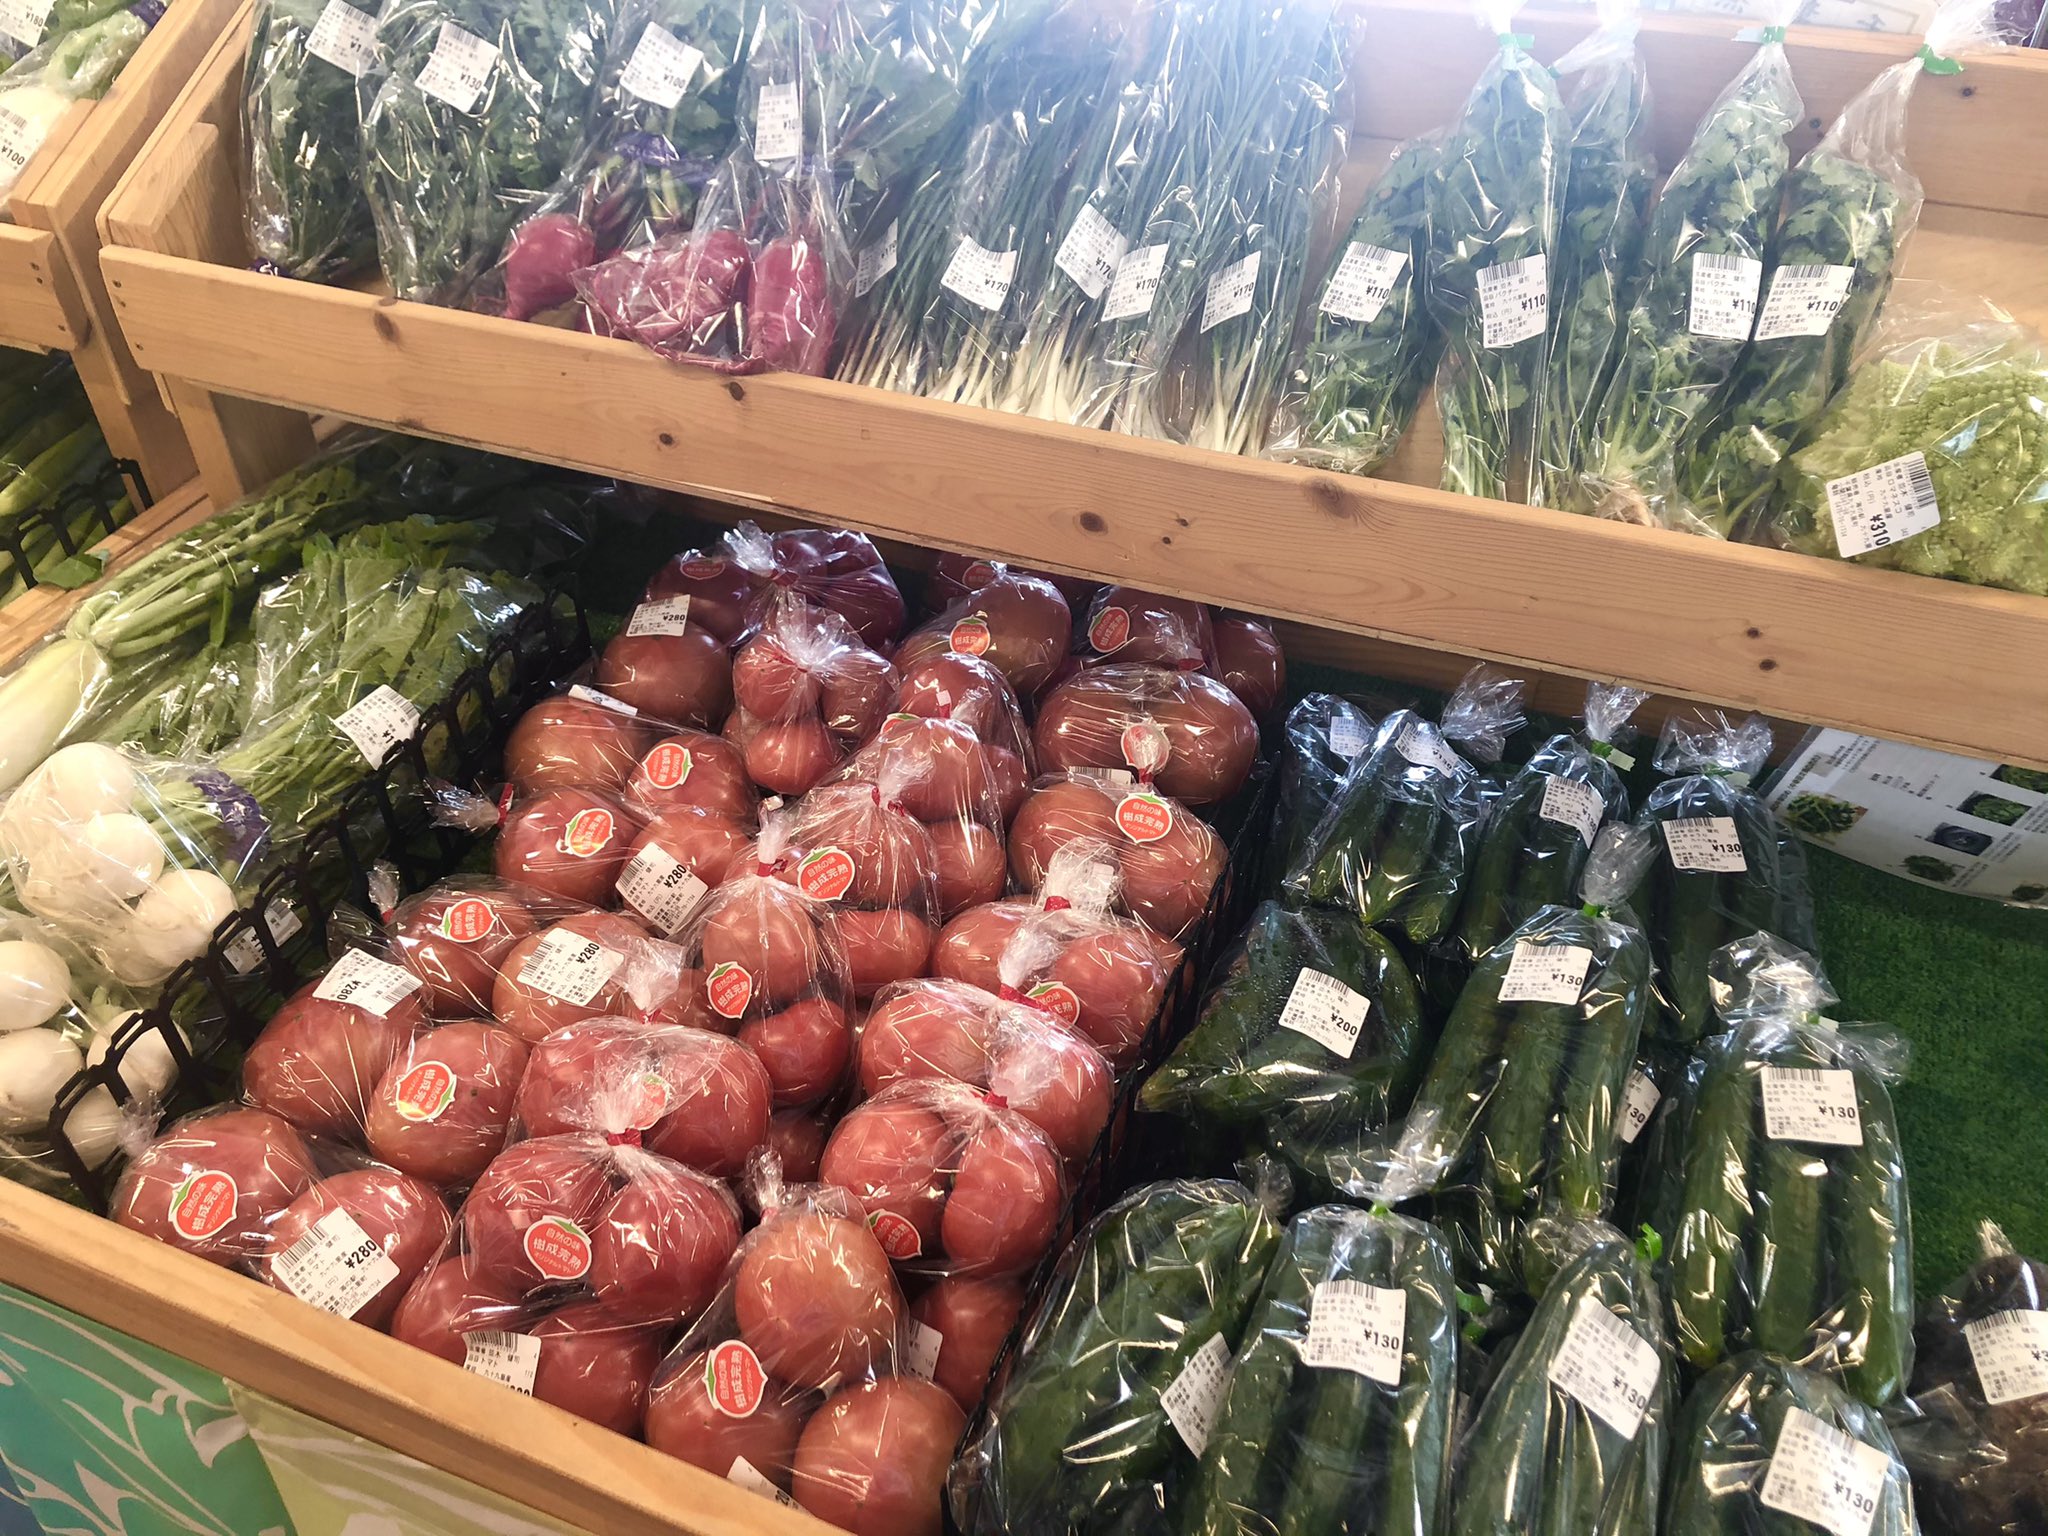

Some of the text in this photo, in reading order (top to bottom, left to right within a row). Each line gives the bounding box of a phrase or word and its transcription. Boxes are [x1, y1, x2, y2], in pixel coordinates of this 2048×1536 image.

[459, 72, 483, 90] ¥130
[663, 74, 686, 89] ¥100
[1, 145, 25, 165] ¥100
[985, 279, 1009, 293] ¥170
[1136, 277, 1158, 291] ¥170
[1234, 282, 1254, 298] ¥170
[1366, 286, 1390, 300] ¥110
[1521, 294, 1546, 311] ¥110
[1732, 299, 1756, 314] ¥110
[1807, 301, 1838, 312] ¥110
[1870, 514, 1891, 546] ¥310
[663, 614, 685, 622] ¥280
[1132, 801, 1163, 817] 自然の味
[1123, 811, 1165, 831] 樹成完熟
[1712, 843, 1741, 853] ¥130
[663, 864, 687, 889] ¥280
[807, 856, 837, 878] 自然の味
[808, 864, 849, 893] 樹成完熟
[576, 943, 600, 964] ¥280
[715, 972, 739, 992] 自然の味
[1552, 973, 1583, 986] ¥130
[336, 980, 362, 1000] ¥280
[717, 980, 749, 1008] 樹成完熟
[1330, 1013, 1358, 1035] ¥200
[1818, 1105, 1856, 1119] ¥130
[182, 1182, 207, 1218] 自然の味
[191, 1181, 227, 1231] 樹成完熟
[545, 1228, 582, 1251] 自然の味
[344, 1240, 377, 1268] ¥280
[533, 1238, 583, 1270] 樹成完熟
[1363, 1328, 1400, 1350] ¥130
[718, 1359, 729, 1400] 自然の味
[731, 1350, 747, 1409] 樹成完熟
[1612, 1376, 1646, 1409] ¥130
[1833, 1481, 1874, 1513] ¥130
